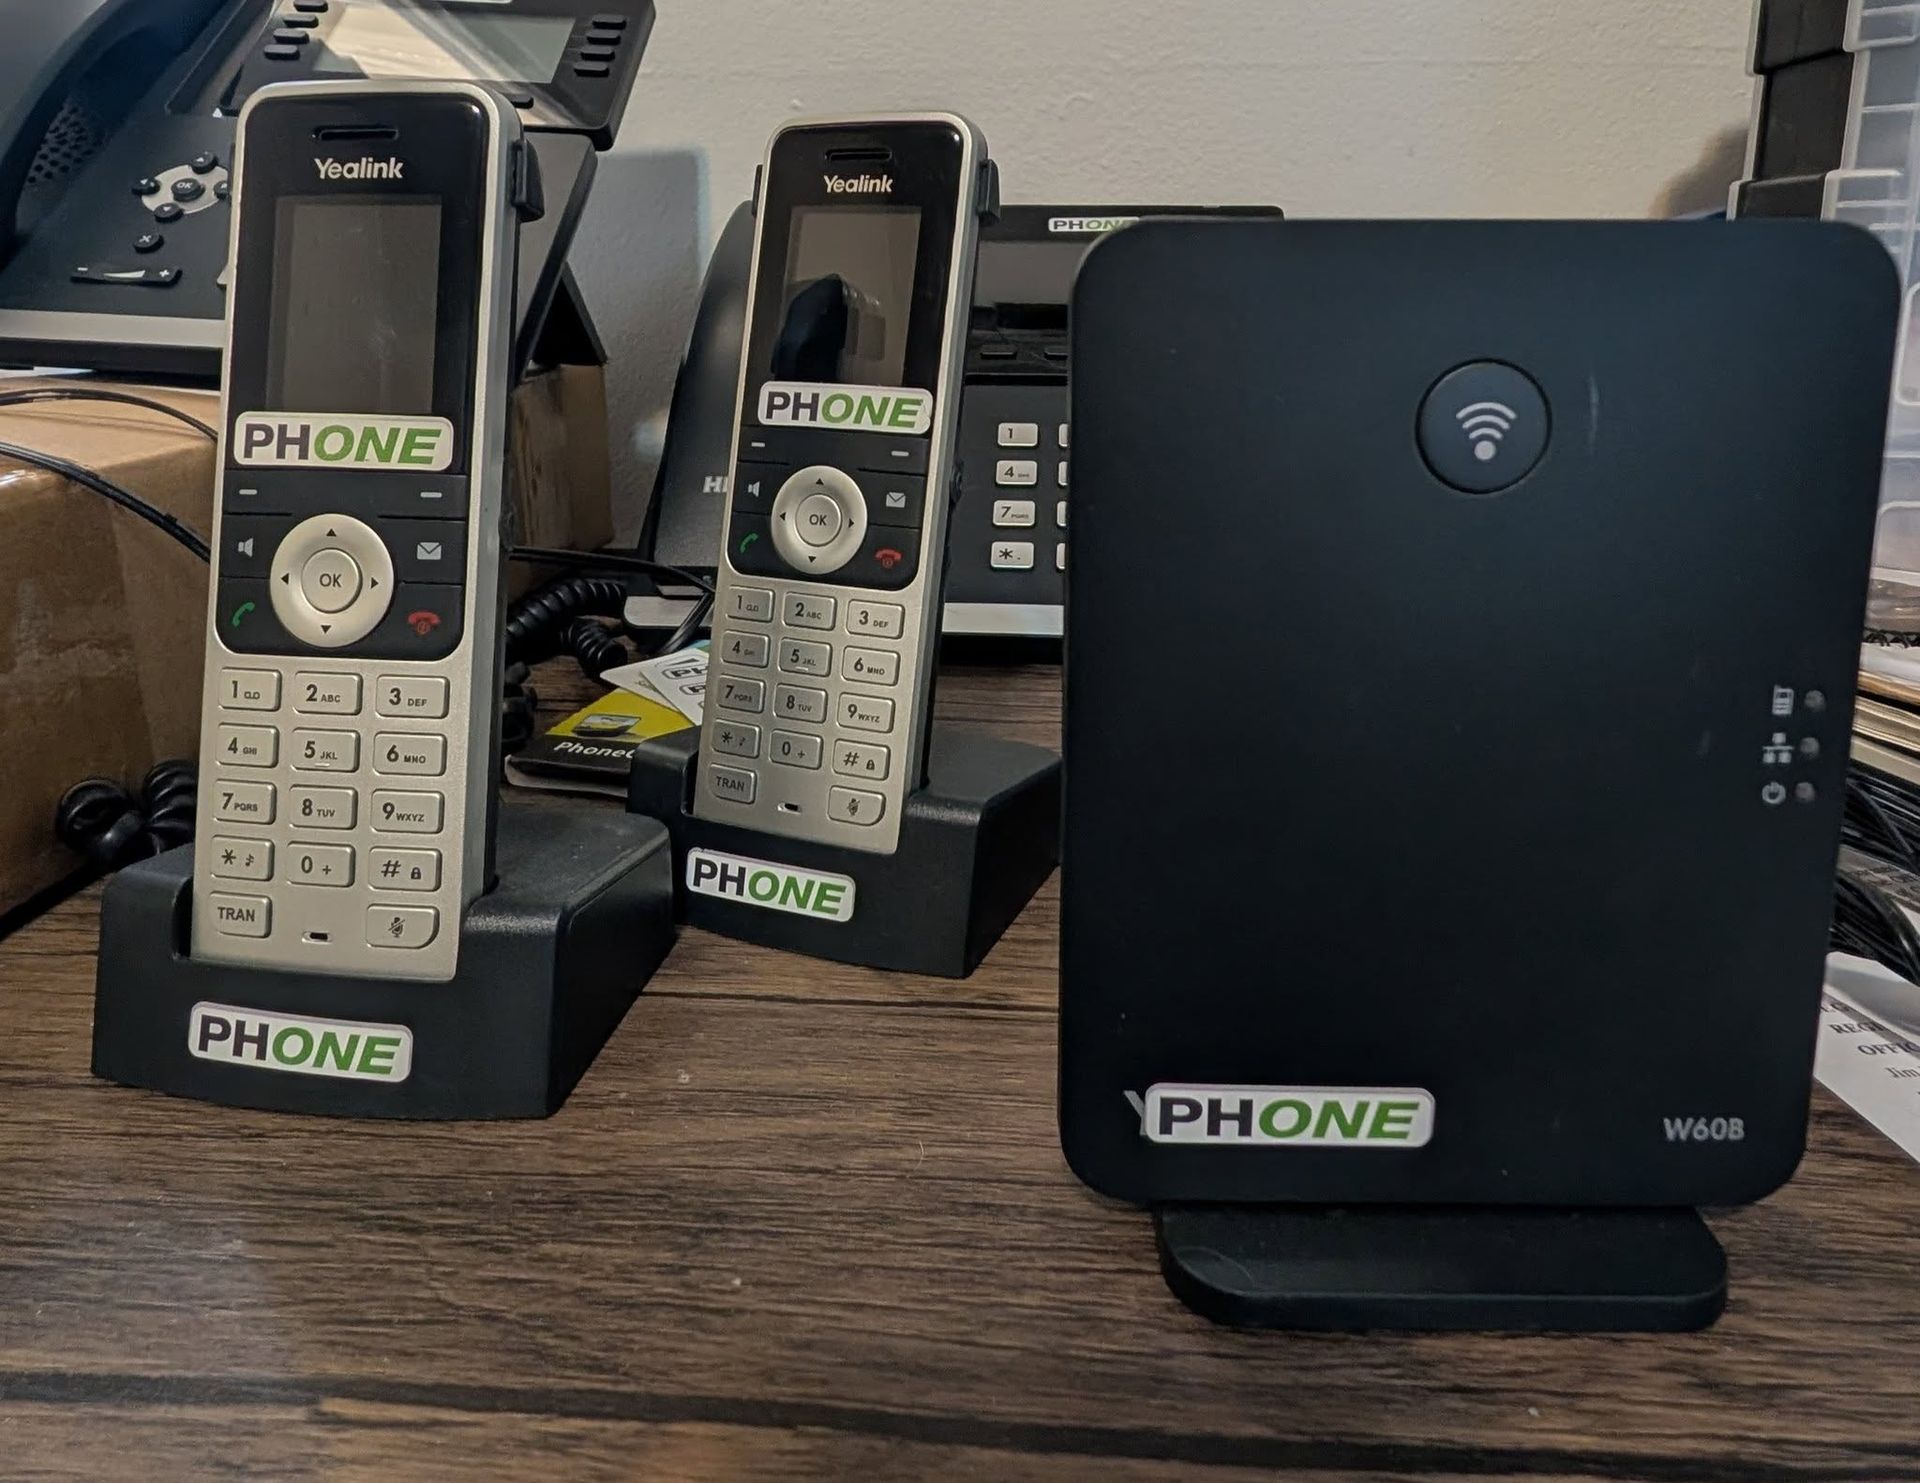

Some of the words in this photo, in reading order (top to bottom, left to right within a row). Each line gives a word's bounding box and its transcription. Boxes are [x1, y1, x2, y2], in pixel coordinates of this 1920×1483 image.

[314, 157, 404, 179] Yealink
[824, 174, 893, 193] Yealink
[1053, 220, 1136, 230] PHON
[765, 391, 924, 428] PHONE
[1008, 428, 1013, 439] 1
[243, 423, 442, 465] PHONE
[1004, 466, 1014, 478] 4
[809, 513, 827, 526] OK
[1001, 506, 1011, 518] 7
[319, 573, 342, 588] OK
[737, 594, 743, 610] 1
[795, 602, 805, 617] 2
[806, 611, 822, 619] ABC
[859, 610, 869, 625] 3
[873, 620, 889, 628] DEF
[732, 640, 741, 654] 4
[790, 648, 800, 663] 5
[854, 657, 864, 672] 6
[867, 667, 885, 675] MNO
[232, 680, 238, 698] 1
[306, 684, 318, 702] 2
[320, 694, 341, 703] ABC
[388, 687, 401, 706] 3
[407, 698, 428, 707] DEF
[725, 685, 735, 698] 7
[786, 695, 795, 710] 8
[798, 703, 812, 712] TUV
[847, 703, 858, 719] 9
[858, 713, 880, 723] WXYZ
[227, 737, 238, 754] 4
[304, 740, 316, 759] 5
[320, 751, 338, 760] JKL
[386, 744, 399, 762] 6
[404, 755, 426, 764] MNO
[782, 741, 791, 756] 0
[843, 752, 860, 766] #
[716, 775, 745, 792] TRAN
[222, 792, 234, 810] 7
[234, 802, 258, 812] PQRS
[301, 798, 313, 816] 8
[317, 809, 335, 817] TUV
[382, 802, 395, 820] 9
[396, 813, 424, 822] WXYZ
[301, 855, 313, 873] 0
[381, 860, 401, 877] #
[692, 857, 847, 916] PHONE
[217, 906, 256, 922] TRAN
[198, 1013, 402, 1075] PHONE
[1159, 1096, 1420, 1139] PHONE
[1663, 1117, 1745, 1141] W60B
